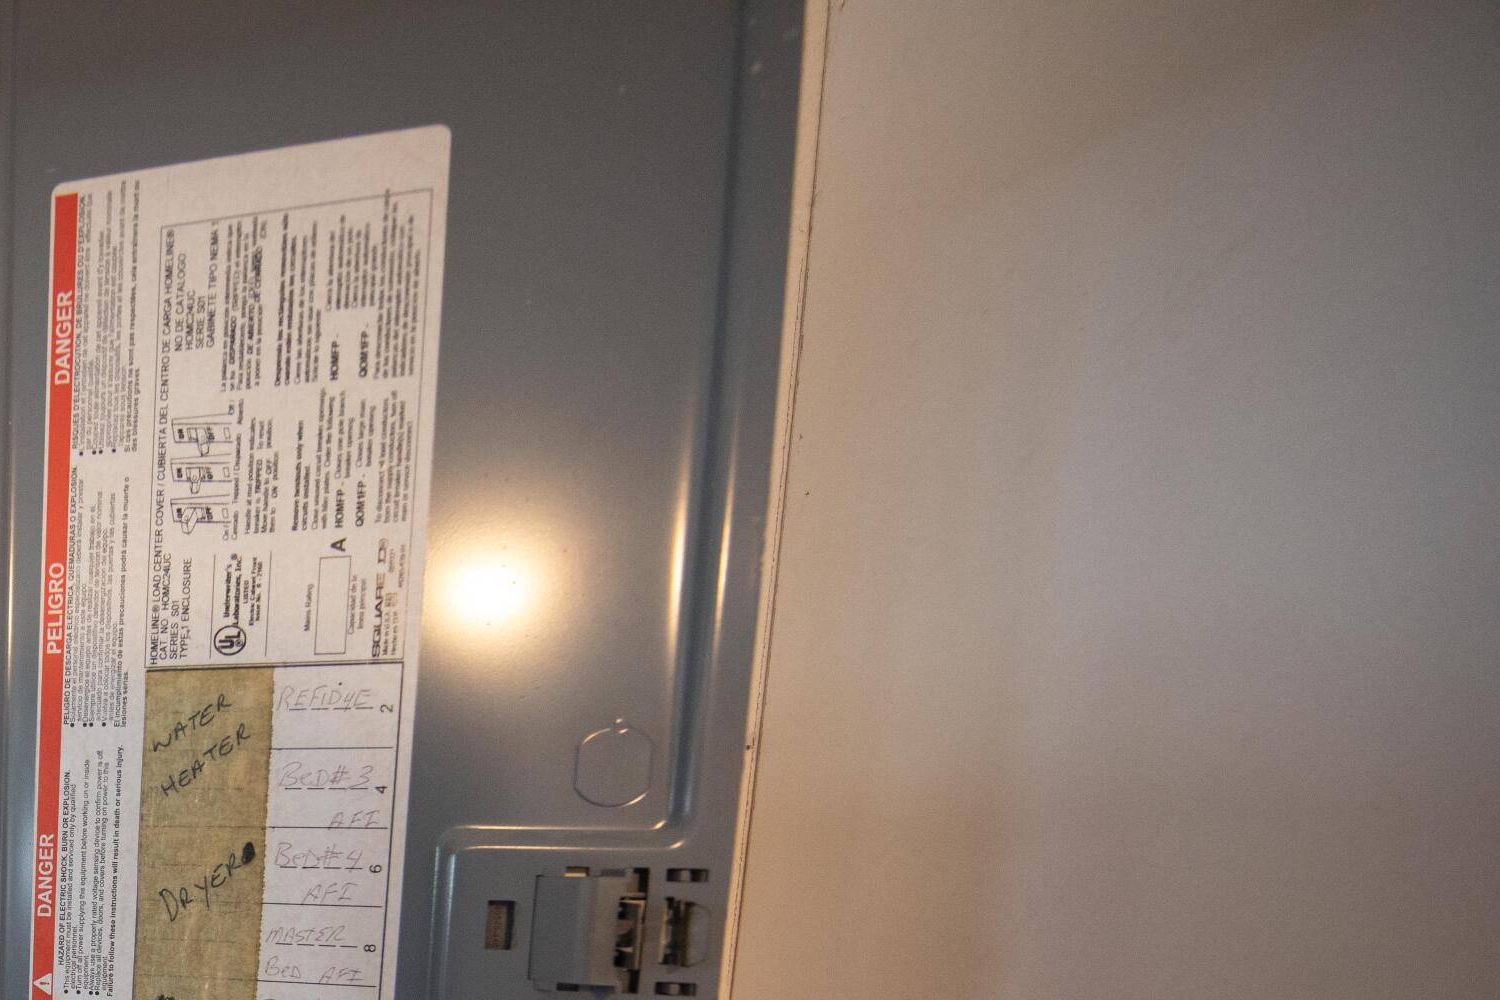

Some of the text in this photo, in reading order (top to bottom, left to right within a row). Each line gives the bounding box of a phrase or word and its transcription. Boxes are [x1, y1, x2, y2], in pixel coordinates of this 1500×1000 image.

[54, 290, 72, 385] DANGER
[162, 298, 171, 336] CARGA
[161, 339, 170, 353] DE
[159, 356, 169, 401] CENTRO
[159, 404, 167, 424] DEL
[157, 428, 167, 481] CUBIERTA
[155, 489, 164, 526] COVER
[153, 529, 163, 572] CENTER
[330, 537, 347, 552] A
[46, 562, 64, 655] PELIGRO
[152, 575, 161, 602] LOAD
[180, 558, 191, 659] TYPE ENCLOSURE
[371, 573, 385, 658] SQUARE
[170, 623, 178, 659] SERIES
[153, 694, 232, 753] WATER
[380, 704, 393, 713] 2
[161, 723, 250, 797] HEATER
[375, 785, 388, 794] 4
[36, 833, 54, 917] DANGER
[59, 923, 65, 933] OF
[62, 818, 68, 828] OR
[158, 853, 241, 922] DRYER
[369, 863, 383, 873] 6
[363, 943, 377, 953] 8
